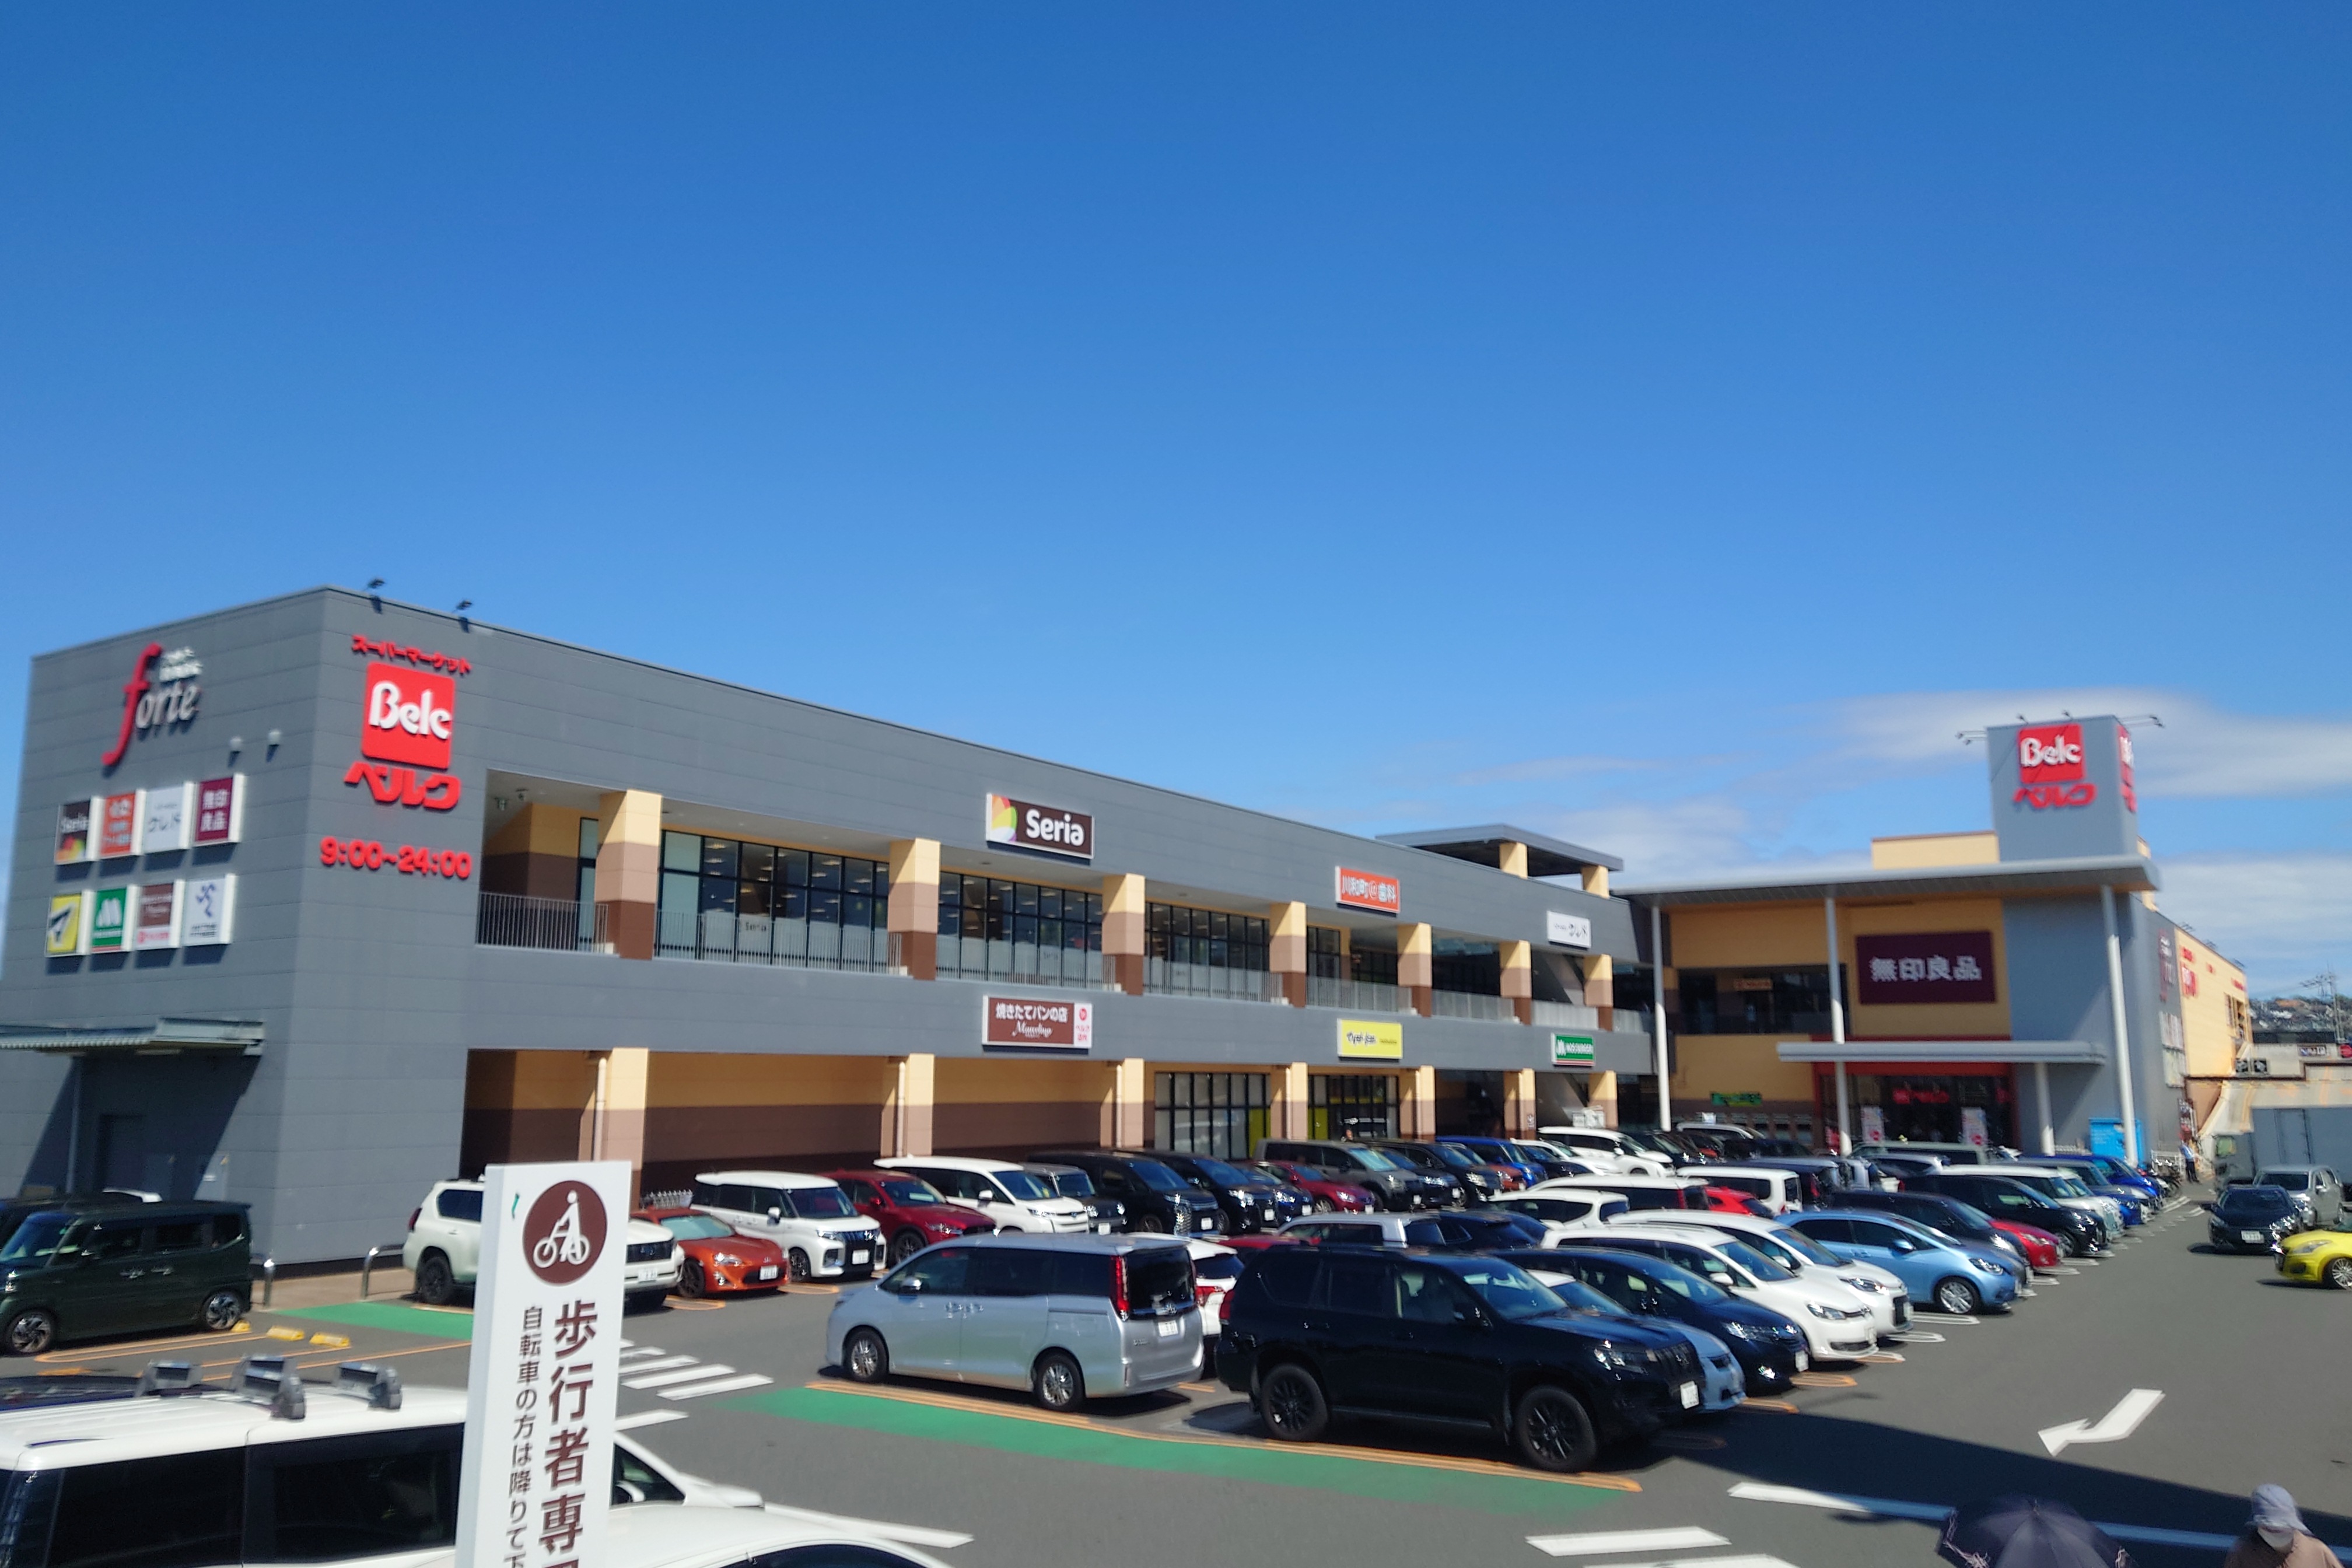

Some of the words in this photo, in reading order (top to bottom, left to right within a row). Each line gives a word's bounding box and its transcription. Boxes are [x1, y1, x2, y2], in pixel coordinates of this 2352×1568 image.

[352, 634, 471, 673] スーパーマーケット
[101, 643, 201, 765] forte
[368, 681, 451, 739] Belc
[2020, 734, 2081, 767] Belc
[344, 762, 461, 809] ベルク
[2013, 783, 2096, 808] ベルク
[1026, 809, 1084, 846] Seria
[1870, 954, 1982, 981] 無印良品
[995, 1002, 1069, 1023] 焼きたてパンの店
[538, 1300, 597, 1568] 歩行者専
